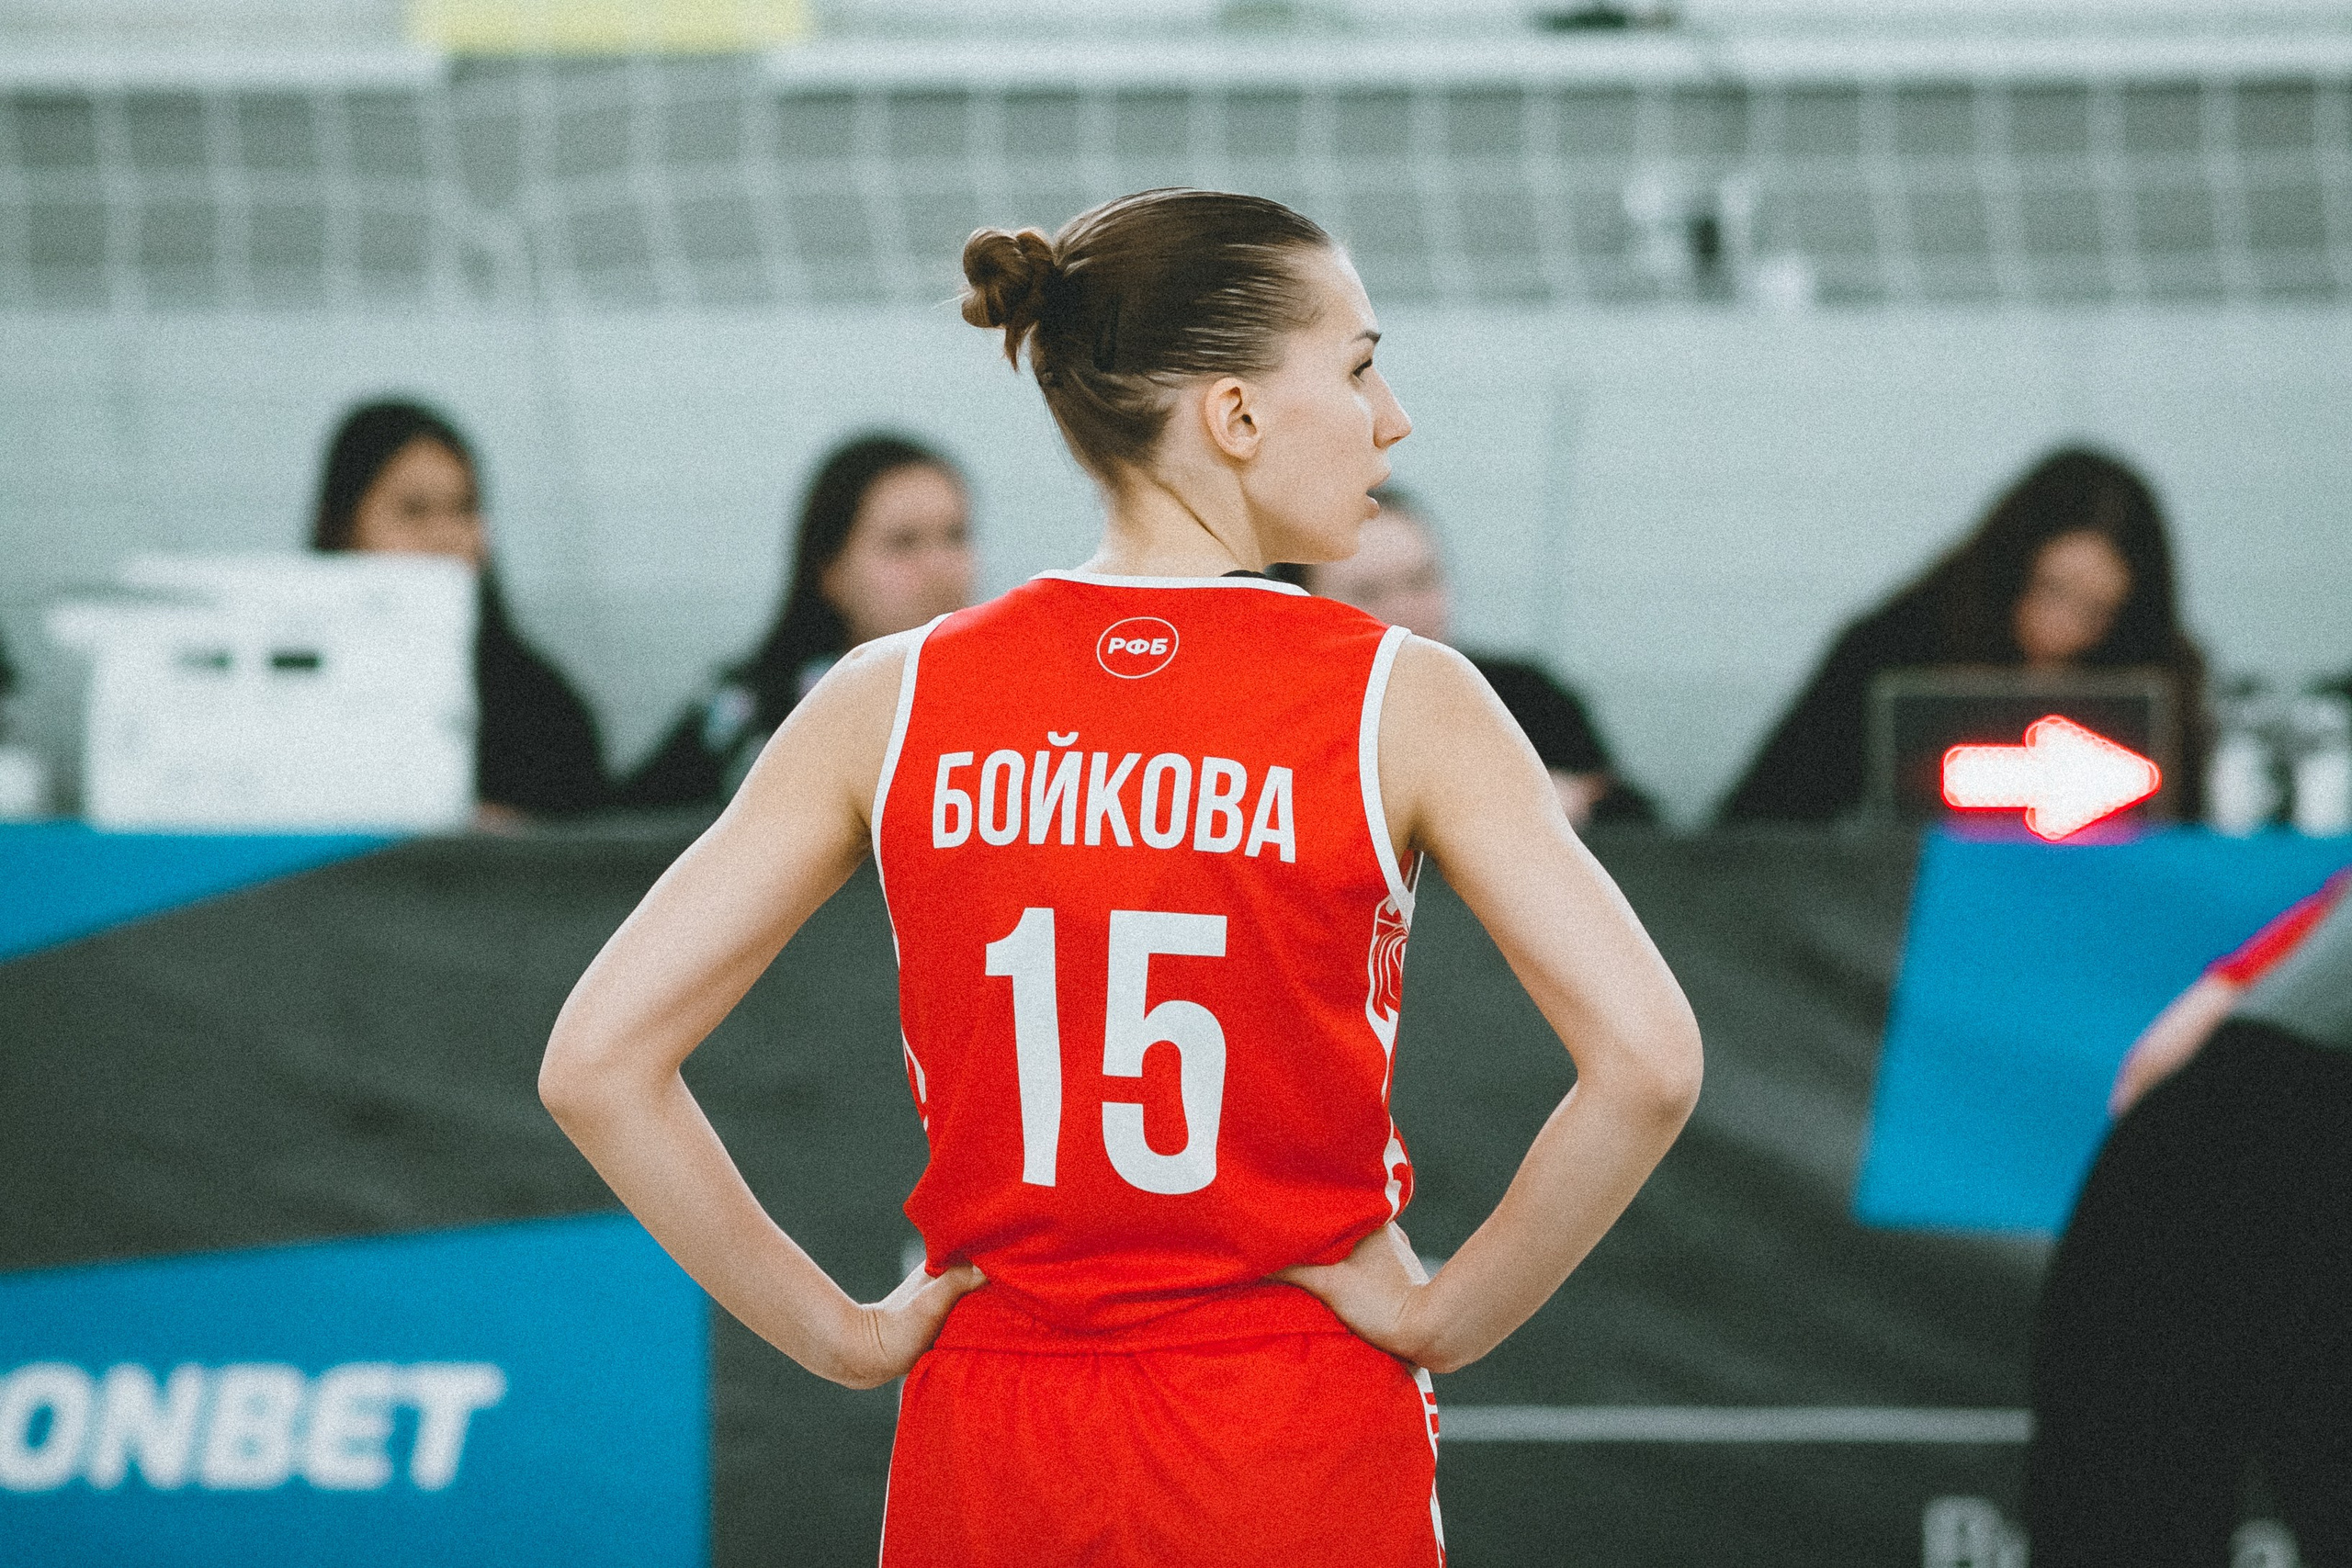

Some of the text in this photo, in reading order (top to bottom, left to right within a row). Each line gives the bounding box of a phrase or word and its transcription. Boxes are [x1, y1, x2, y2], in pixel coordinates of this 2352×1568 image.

[1107, 637, 1169, 656] РФБ
[932, 731, 1296, 863] БОЙКОВА
[985, 907, 1227, 1195] 15
